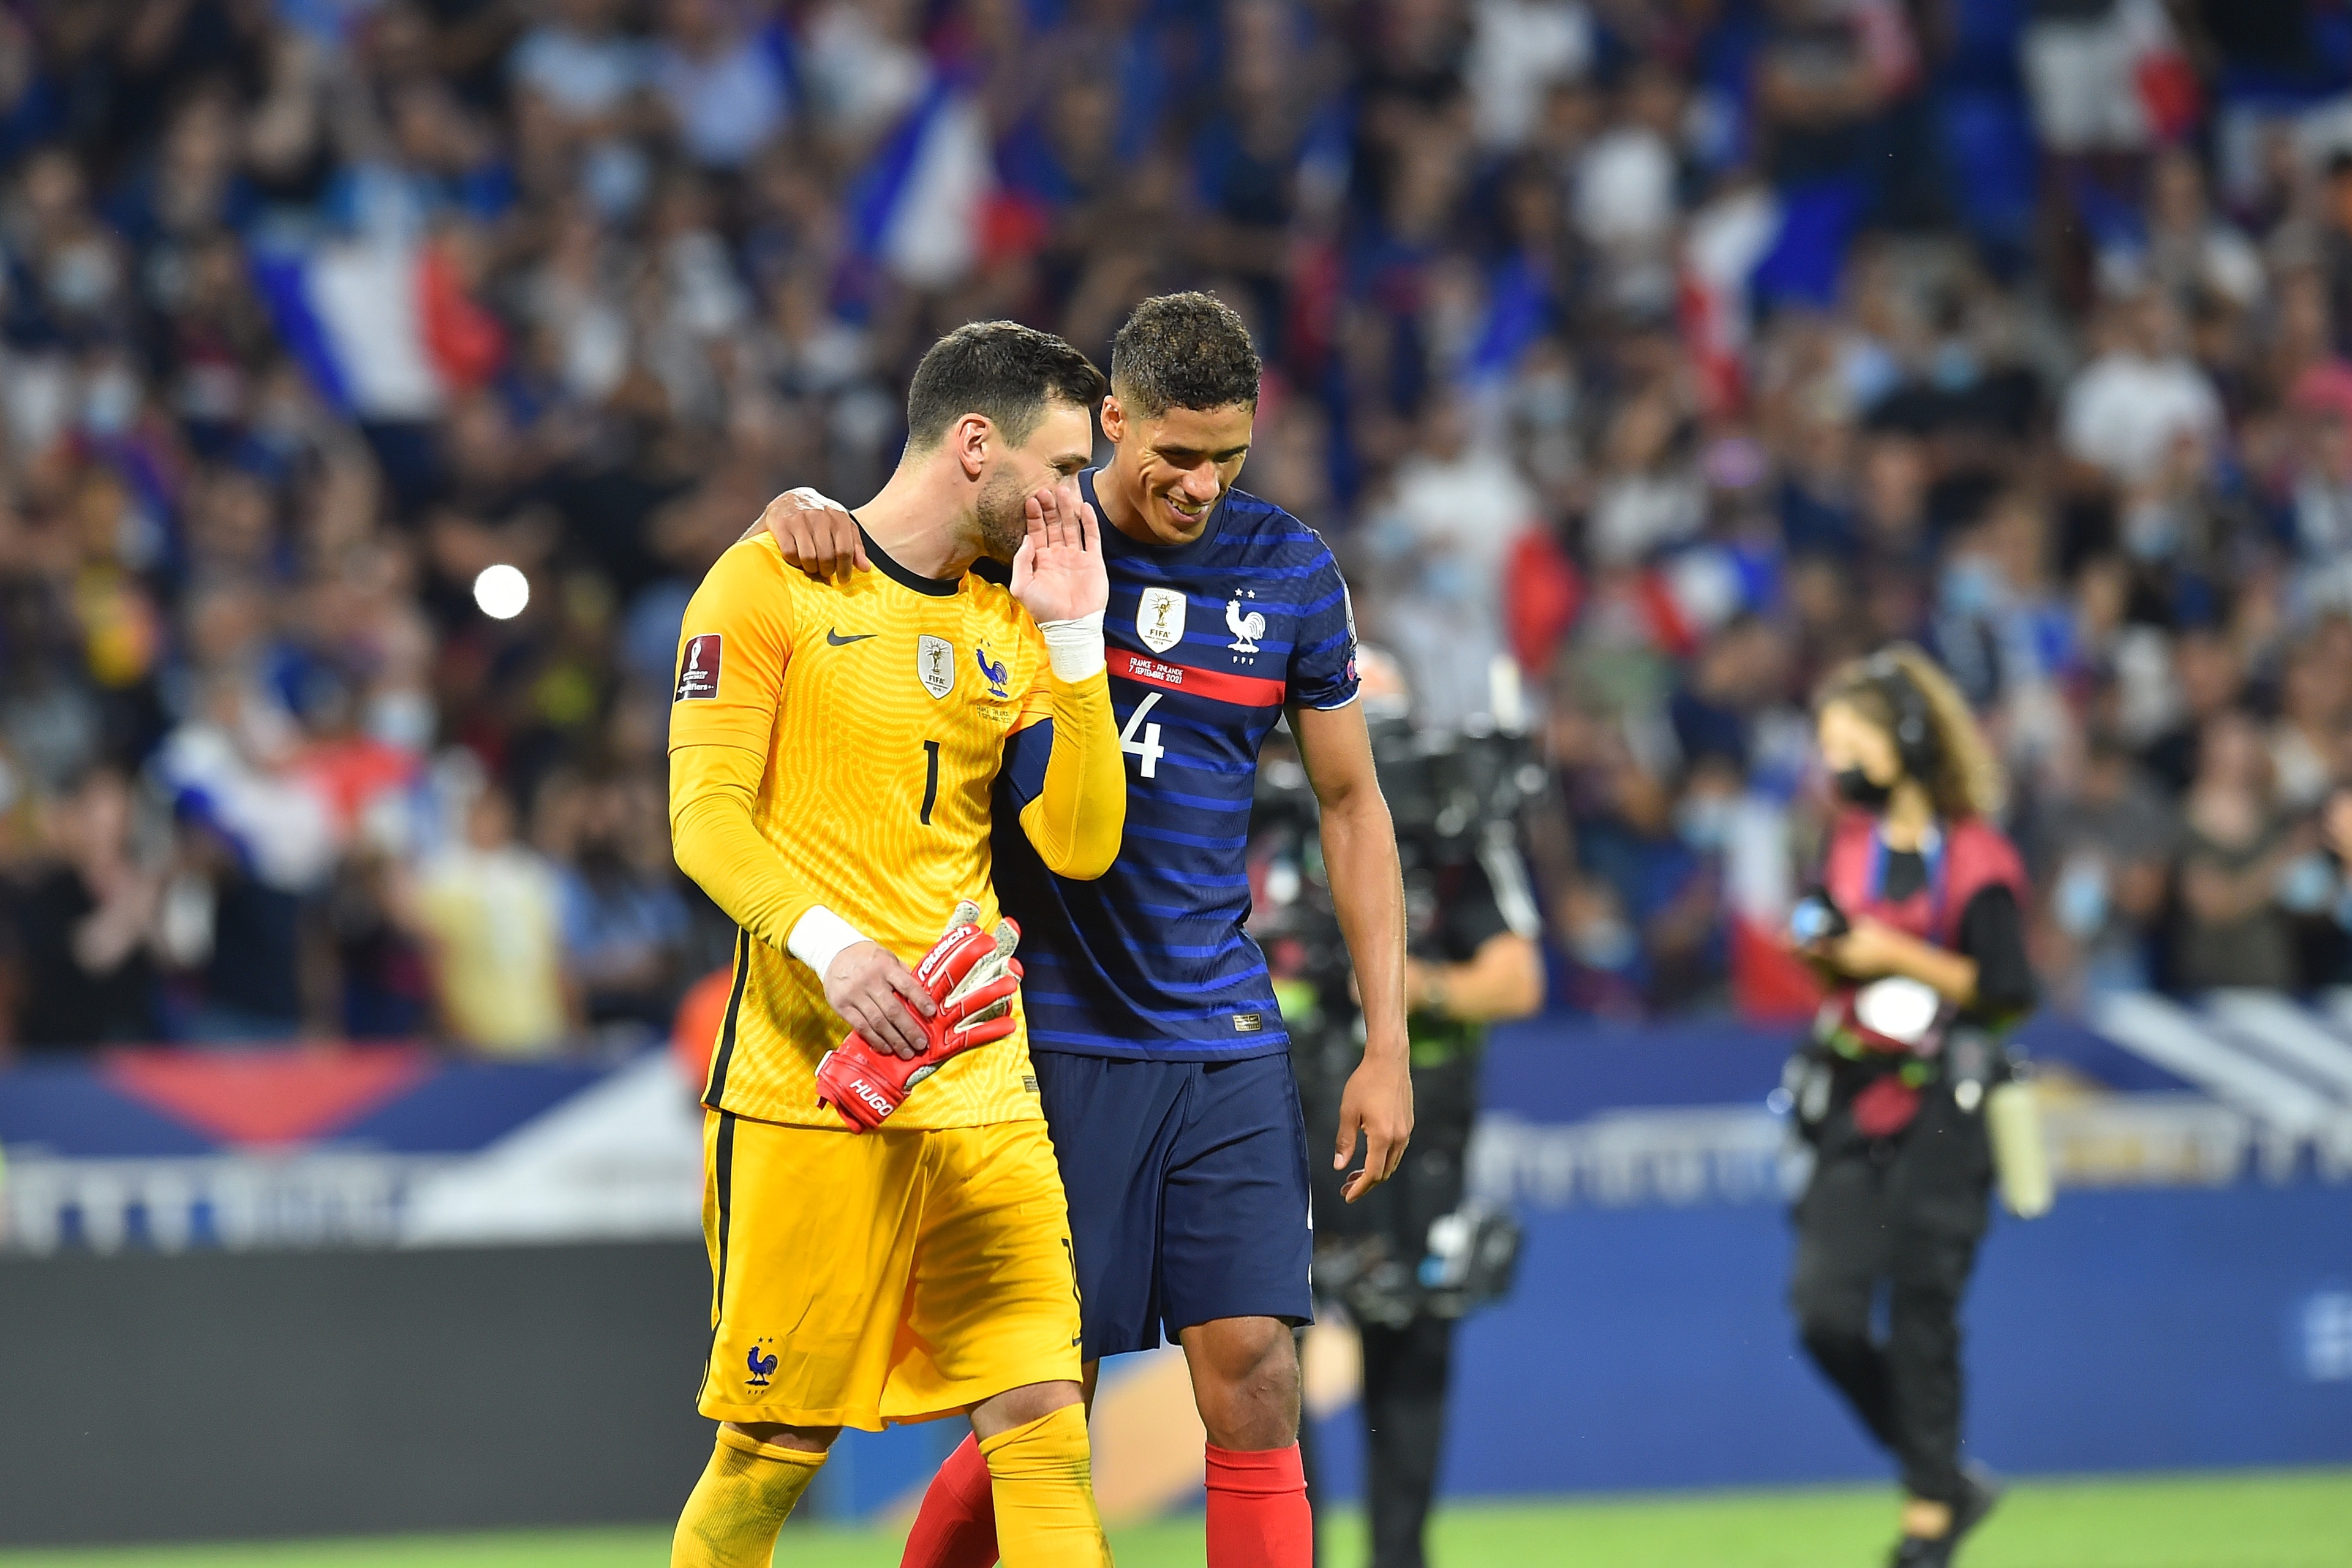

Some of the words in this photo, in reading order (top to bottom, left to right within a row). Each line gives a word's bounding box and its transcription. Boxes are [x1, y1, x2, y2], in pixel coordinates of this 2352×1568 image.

[1150, 628, 1169, 638] FIFA
[929, 674, 944, 685] FIFA
[1129, 657, 1152, 669] FRANCE
[1156, 663, 1183, 676] FINLANDE
[1134, 667, 1165, 680] SEPTEMBRE
[1165, 673, 1183, 684] 2021
[1120, 692, 1164, 778] 4
[920, 740, 940, 825] 1
[918, 926, 972, 981] reusch
[849, 1078, 894, 1117] HUGO
